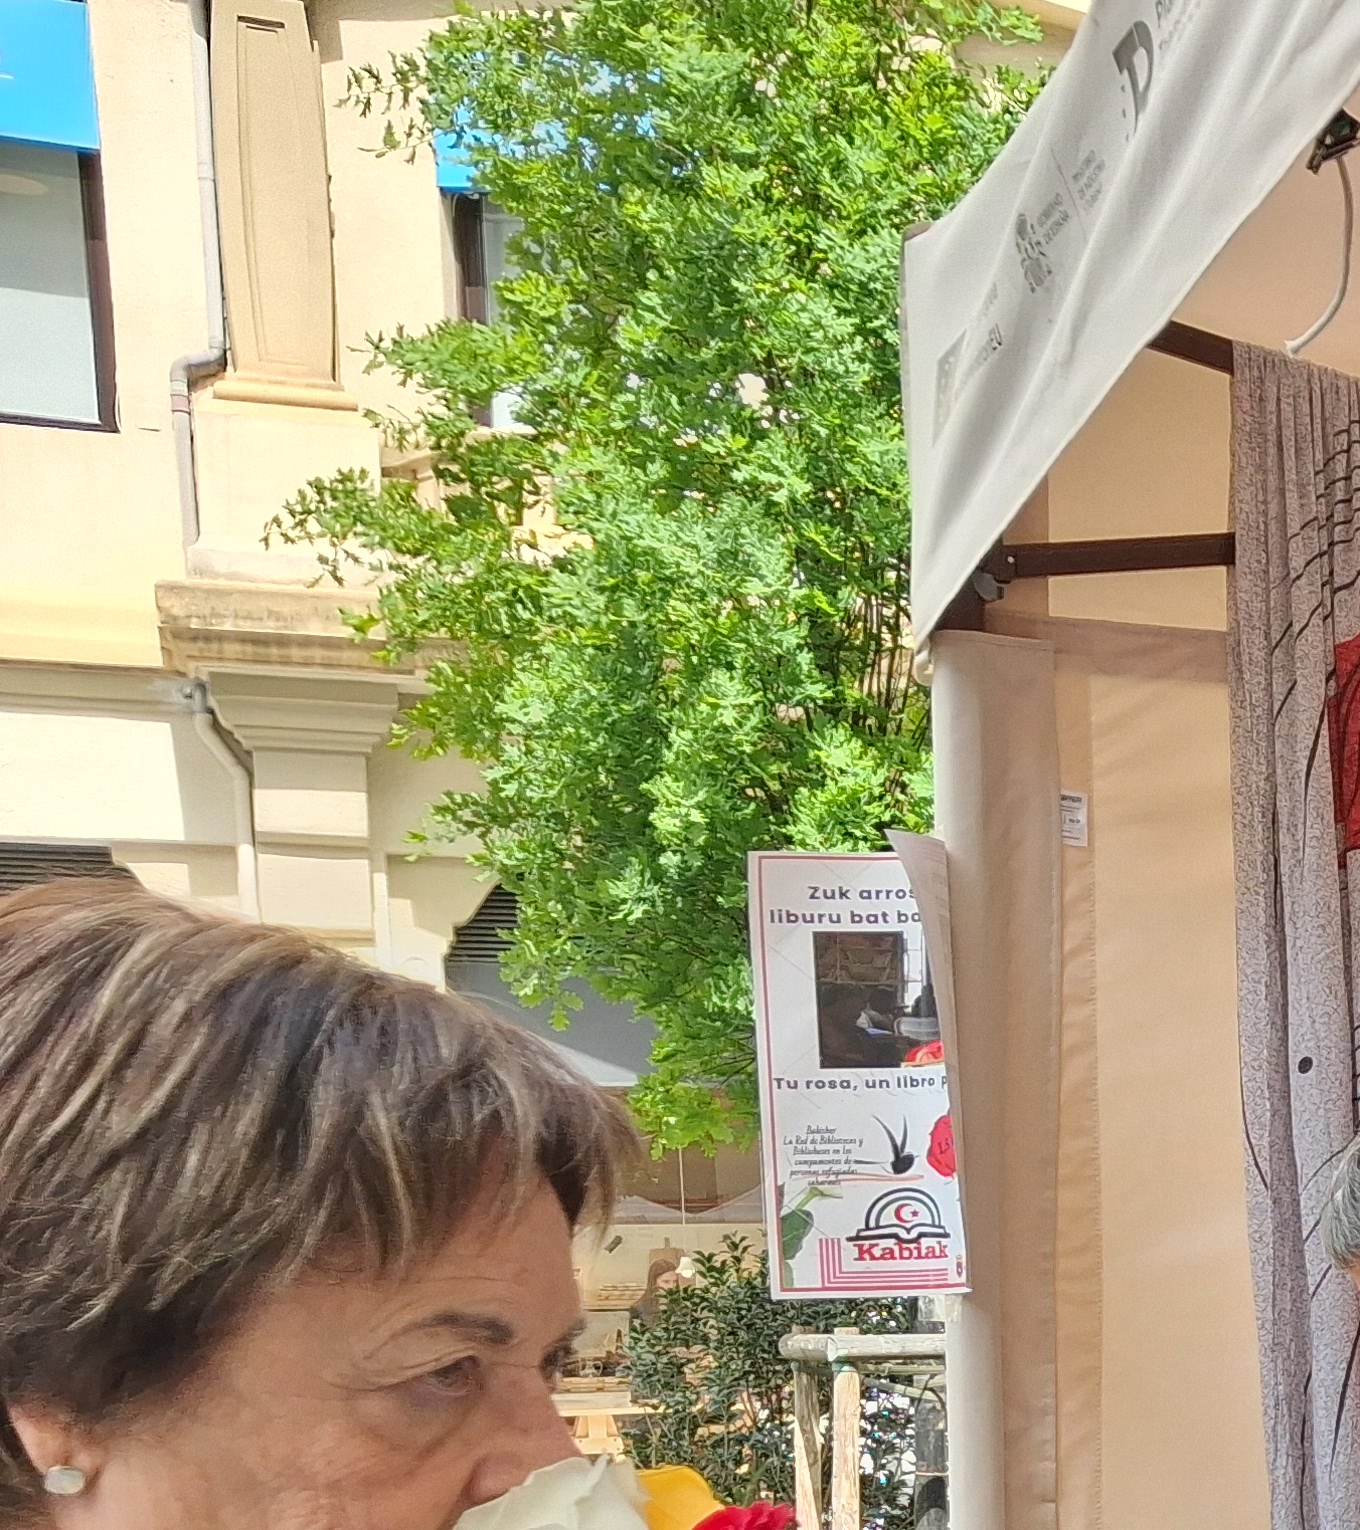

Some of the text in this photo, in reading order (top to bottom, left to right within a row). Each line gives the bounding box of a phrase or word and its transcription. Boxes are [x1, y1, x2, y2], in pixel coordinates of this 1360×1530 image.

[807, 886, 850, 900] Zuk
[769, 909, 842, 924] liburu
[850, 910, 889, 924] bat
[774, 1078, 799, 1090] Tu
[805, 1079, 858, 1091] rosa,
[865, 1078, 890, 1090] un
[897, 1075, 935, 1089] libro
[783, 1135, 793, 1145] La
[795, 1135, 808, 1145] Red
[853, 1240, 949, 1262] Kabiak
